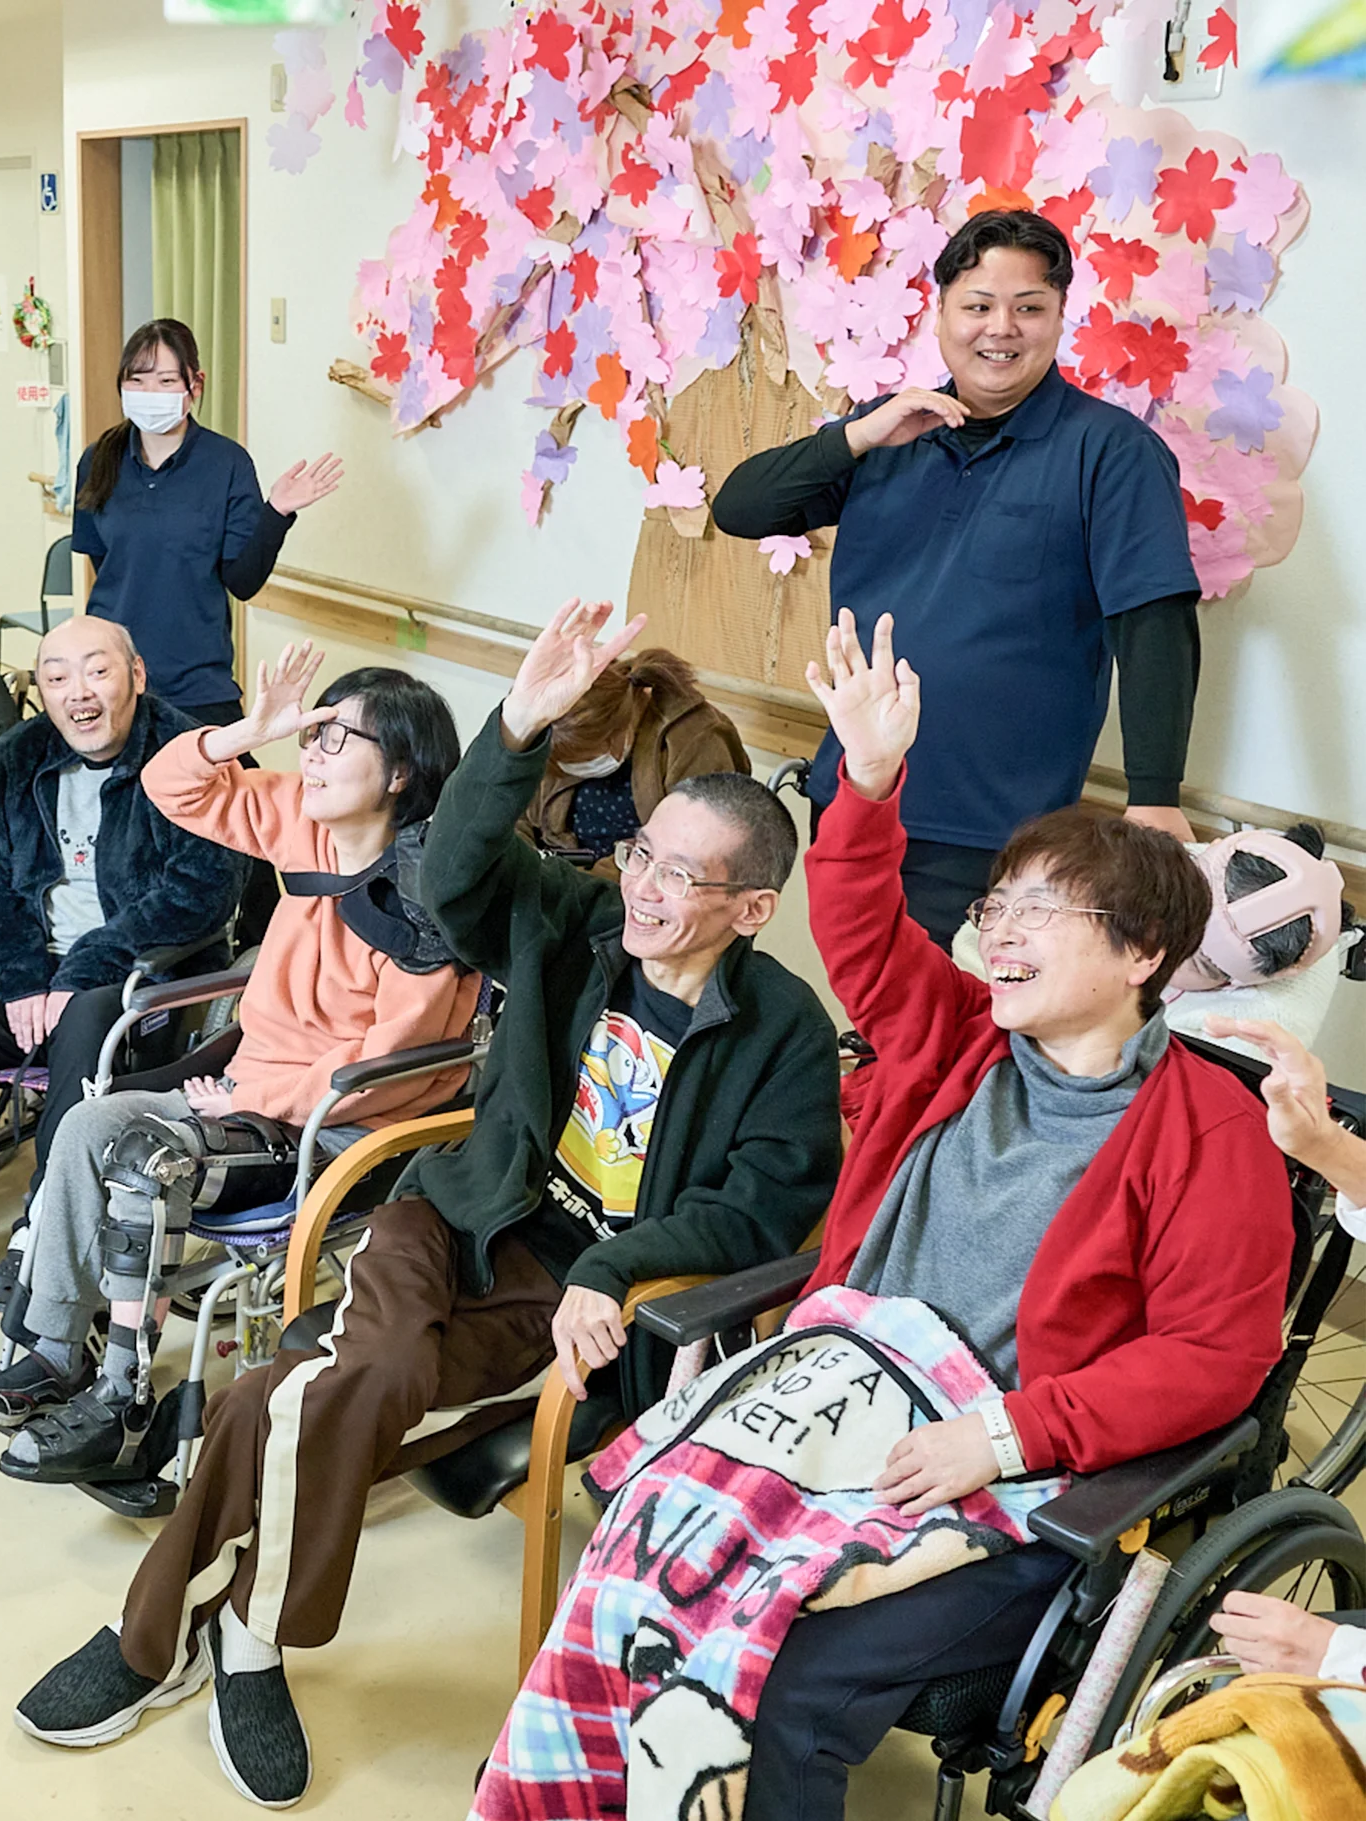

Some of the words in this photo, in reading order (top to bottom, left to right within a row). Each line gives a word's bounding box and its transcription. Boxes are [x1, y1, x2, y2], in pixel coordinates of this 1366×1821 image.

[17, 385, 49, 401] 使用中
[721, 1397, 811, 1455] KET!
[814, 1396, 848, 1436] A
